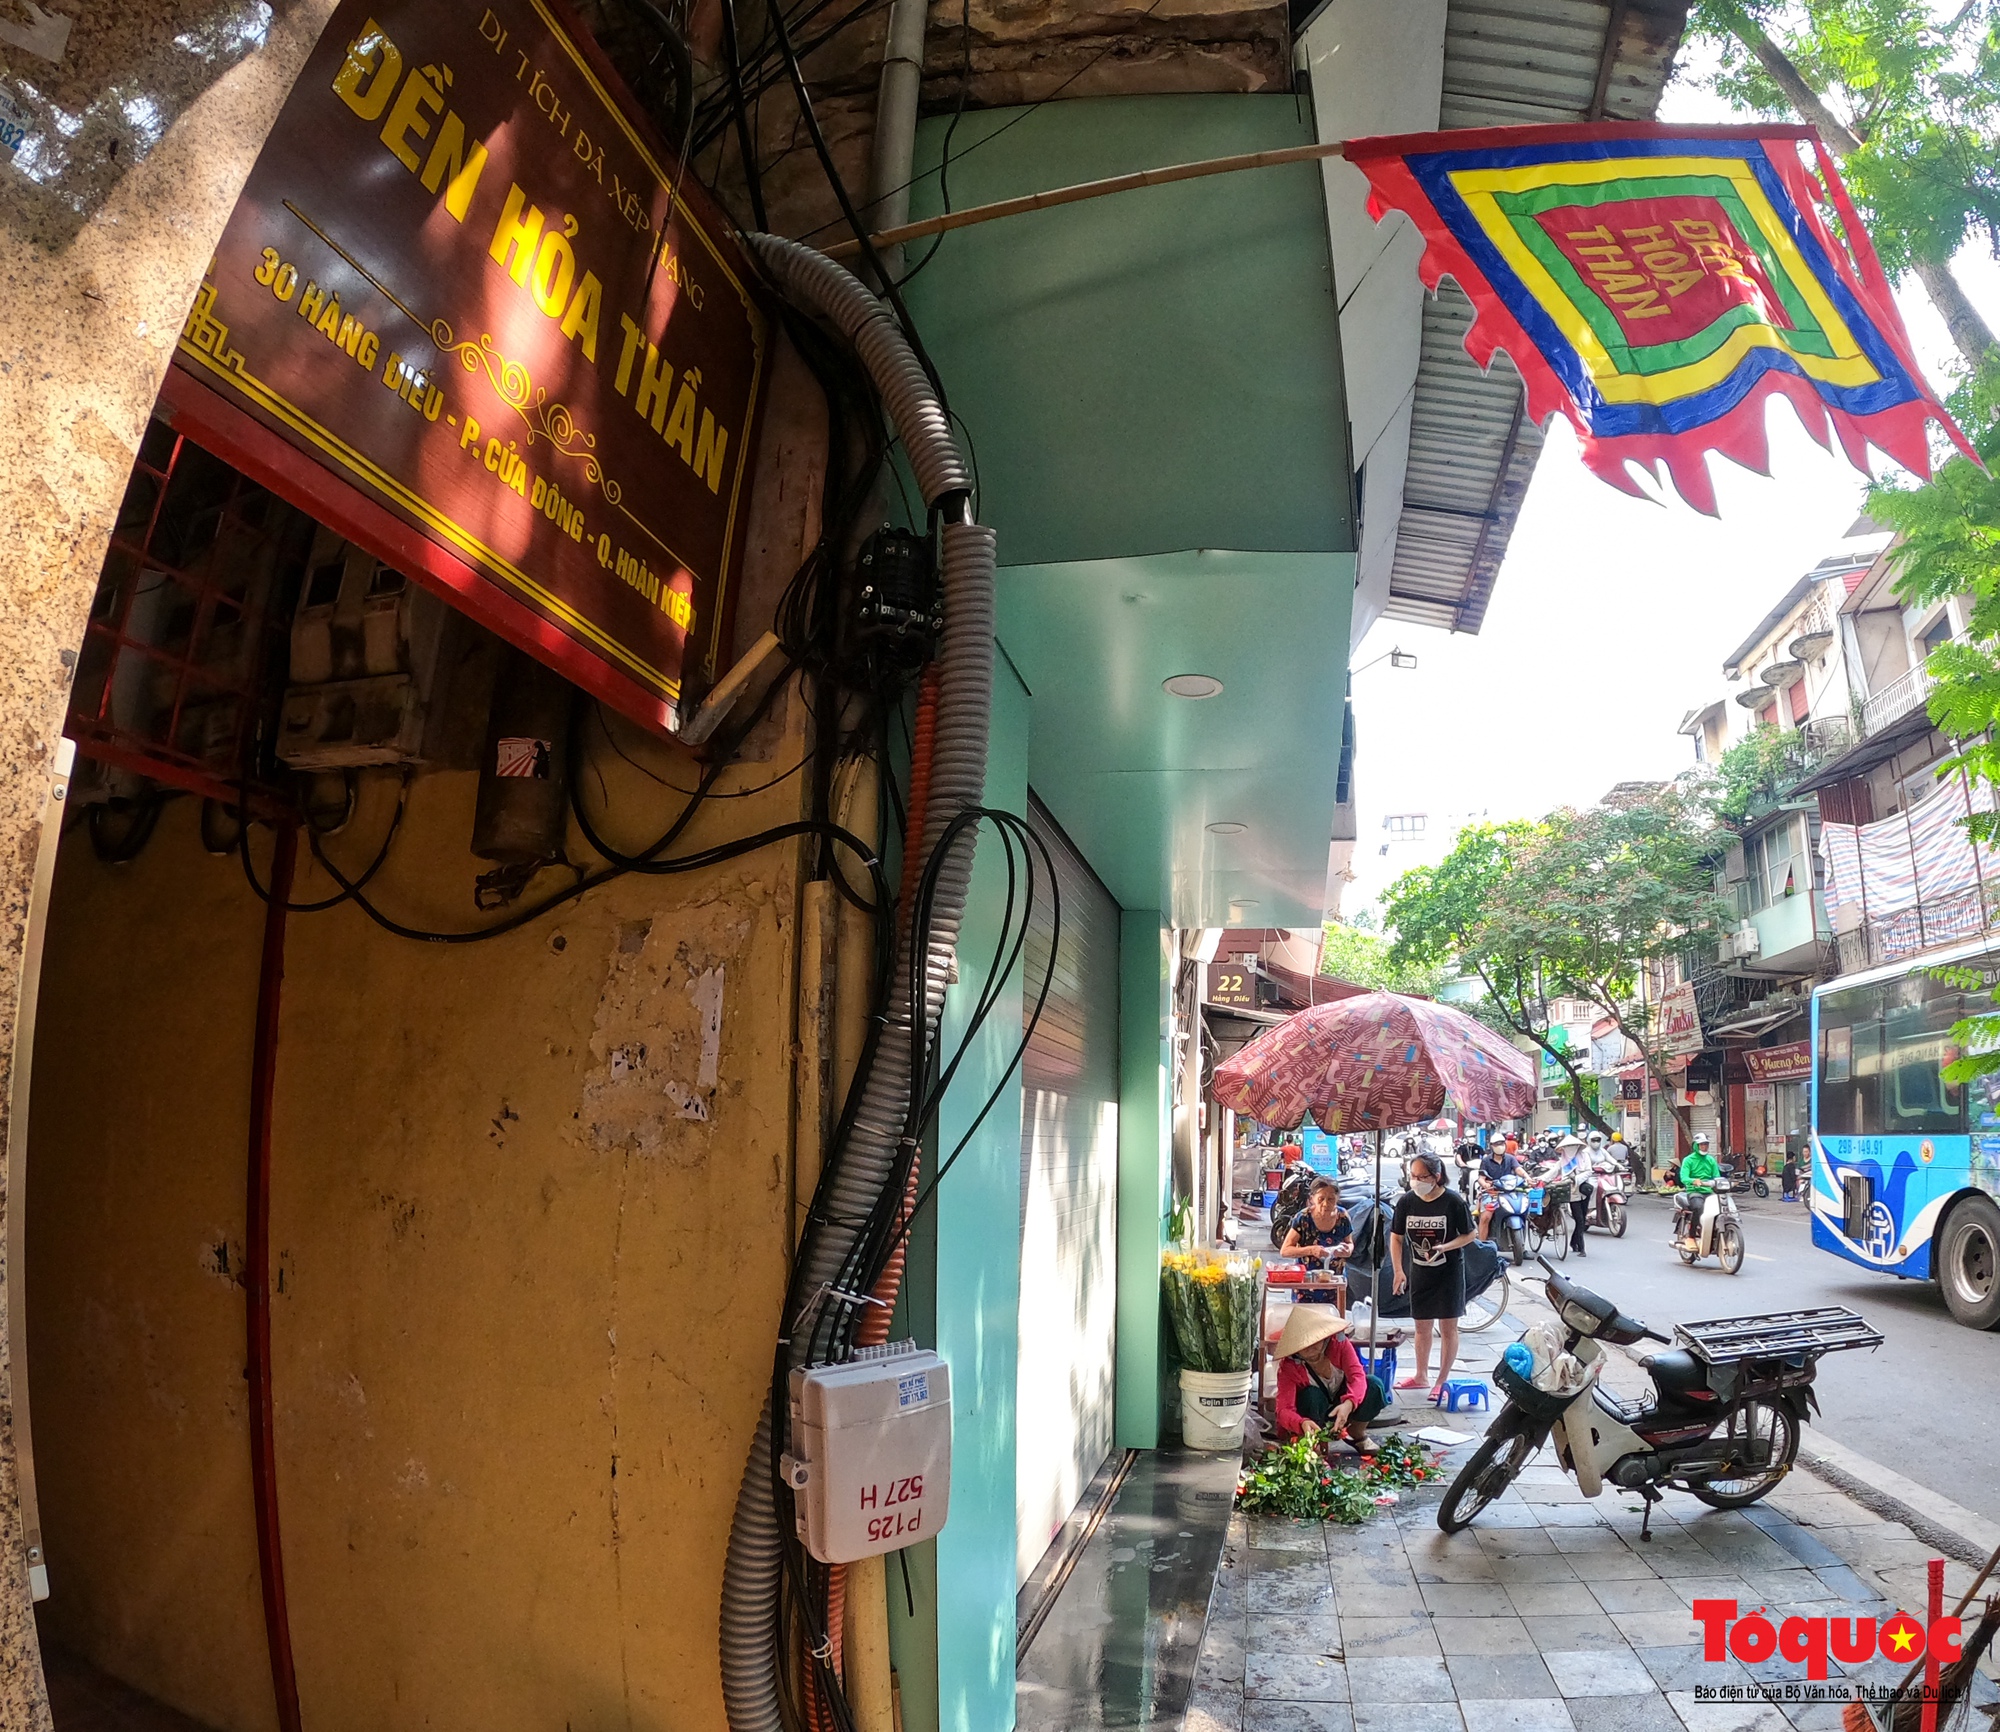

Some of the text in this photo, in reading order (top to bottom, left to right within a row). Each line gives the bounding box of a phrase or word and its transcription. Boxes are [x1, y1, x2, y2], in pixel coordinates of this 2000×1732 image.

[478, 8, 508, 55] DI
[515, 49, 571, 137] TÍCH
[608, 174, 650, 232] XẾP
[652, 230, 705, 312] HẠNG
[331, 17, 729, 495] ĐỀN HỎA THẦN
[254, 247, 298, 302] 30
[297, 280, 380, 371] HÀNG
[382, 351, 444, 422] ĐIẾU
[460, 415, 480, 459] P.
[484, 437, 527, 497] CỬA
[530, 475, 585, 543] ĐÔNG
[597, 533, 613, 570] Q.
[615, 547, 660, 605] HOÀN
[1217, 975, 1243, 992] 22
[1212, 994, 1231, 1003] Hàng
[1793, 1052, 1811, 1066] Sen
[1407, 1219, 1445, 1228] adidas
[1201, 1398, 1221, 1407] Sejin
[860, 1474, 923, 1510] 527 H
[867, 1508, 922, 1542] P125
